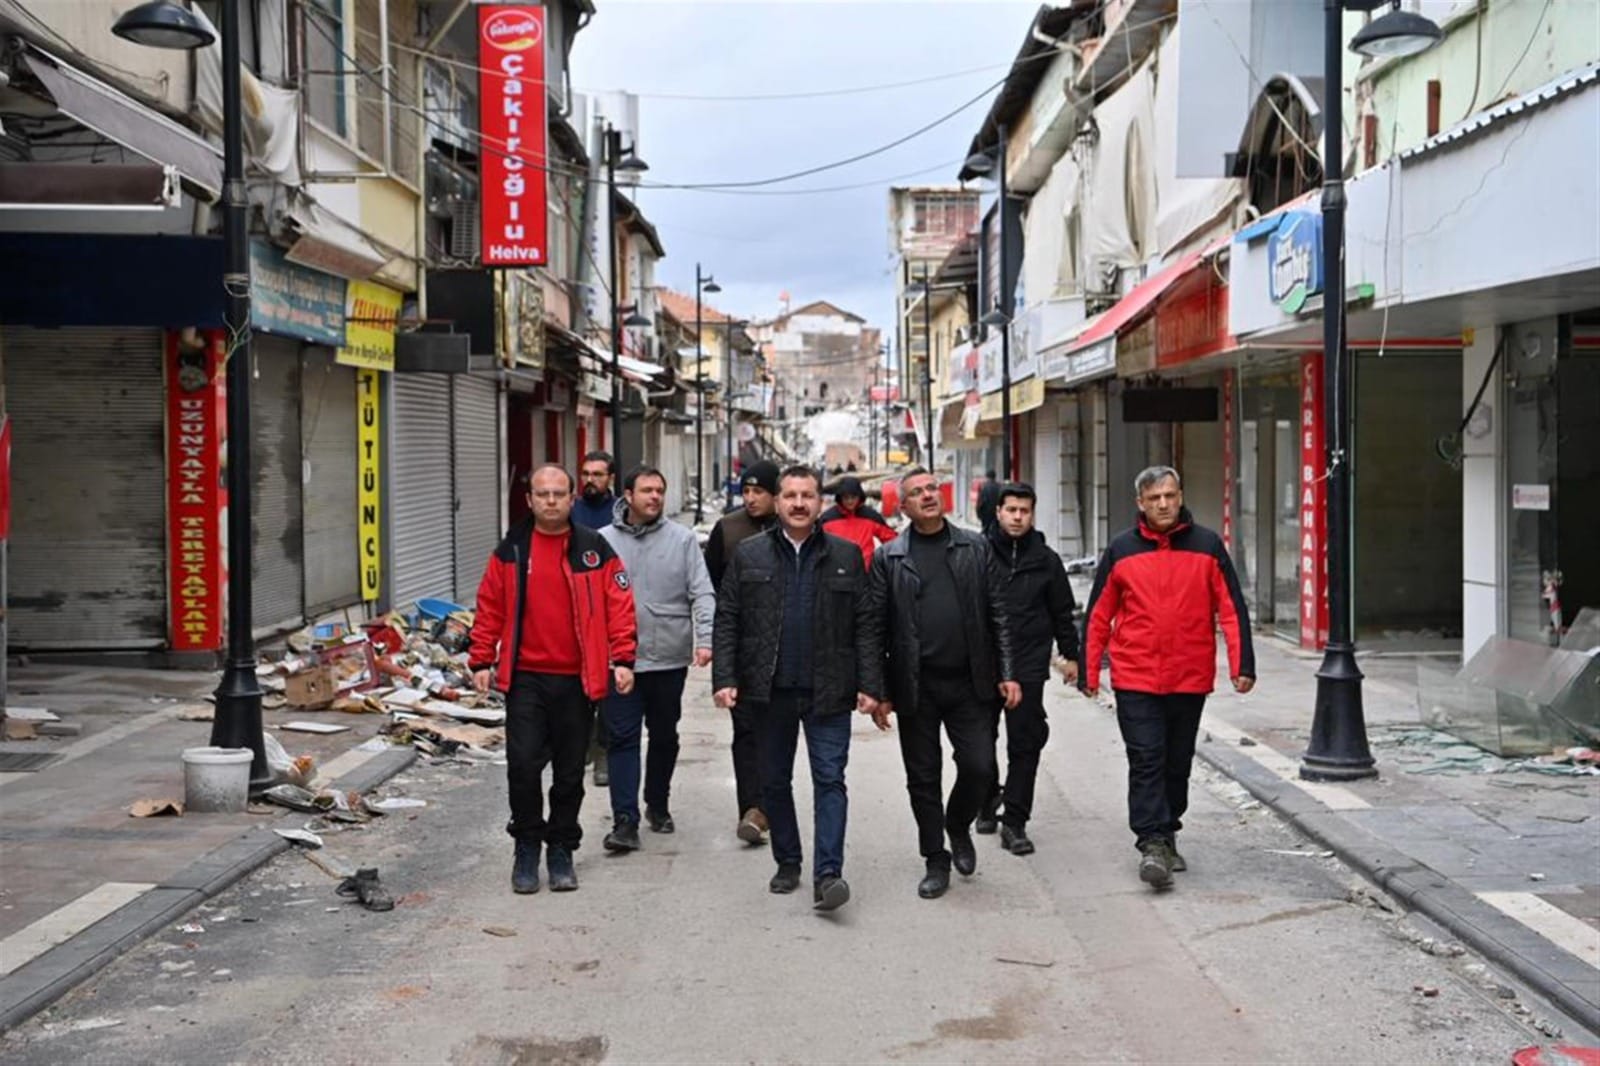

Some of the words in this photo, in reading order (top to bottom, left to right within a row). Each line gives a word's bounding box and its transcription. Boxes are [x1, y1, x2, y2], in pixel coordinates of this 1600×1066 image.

[489, 245, 540, 259] Helva
[179, 400, 205, 504] UZUNYAYLA
[1303, 362, 1314, 449] CARE
[363, 375, 377, 589] TÜTÜNCÜ
[1302, 465, 1314, 619] BAHARAT
